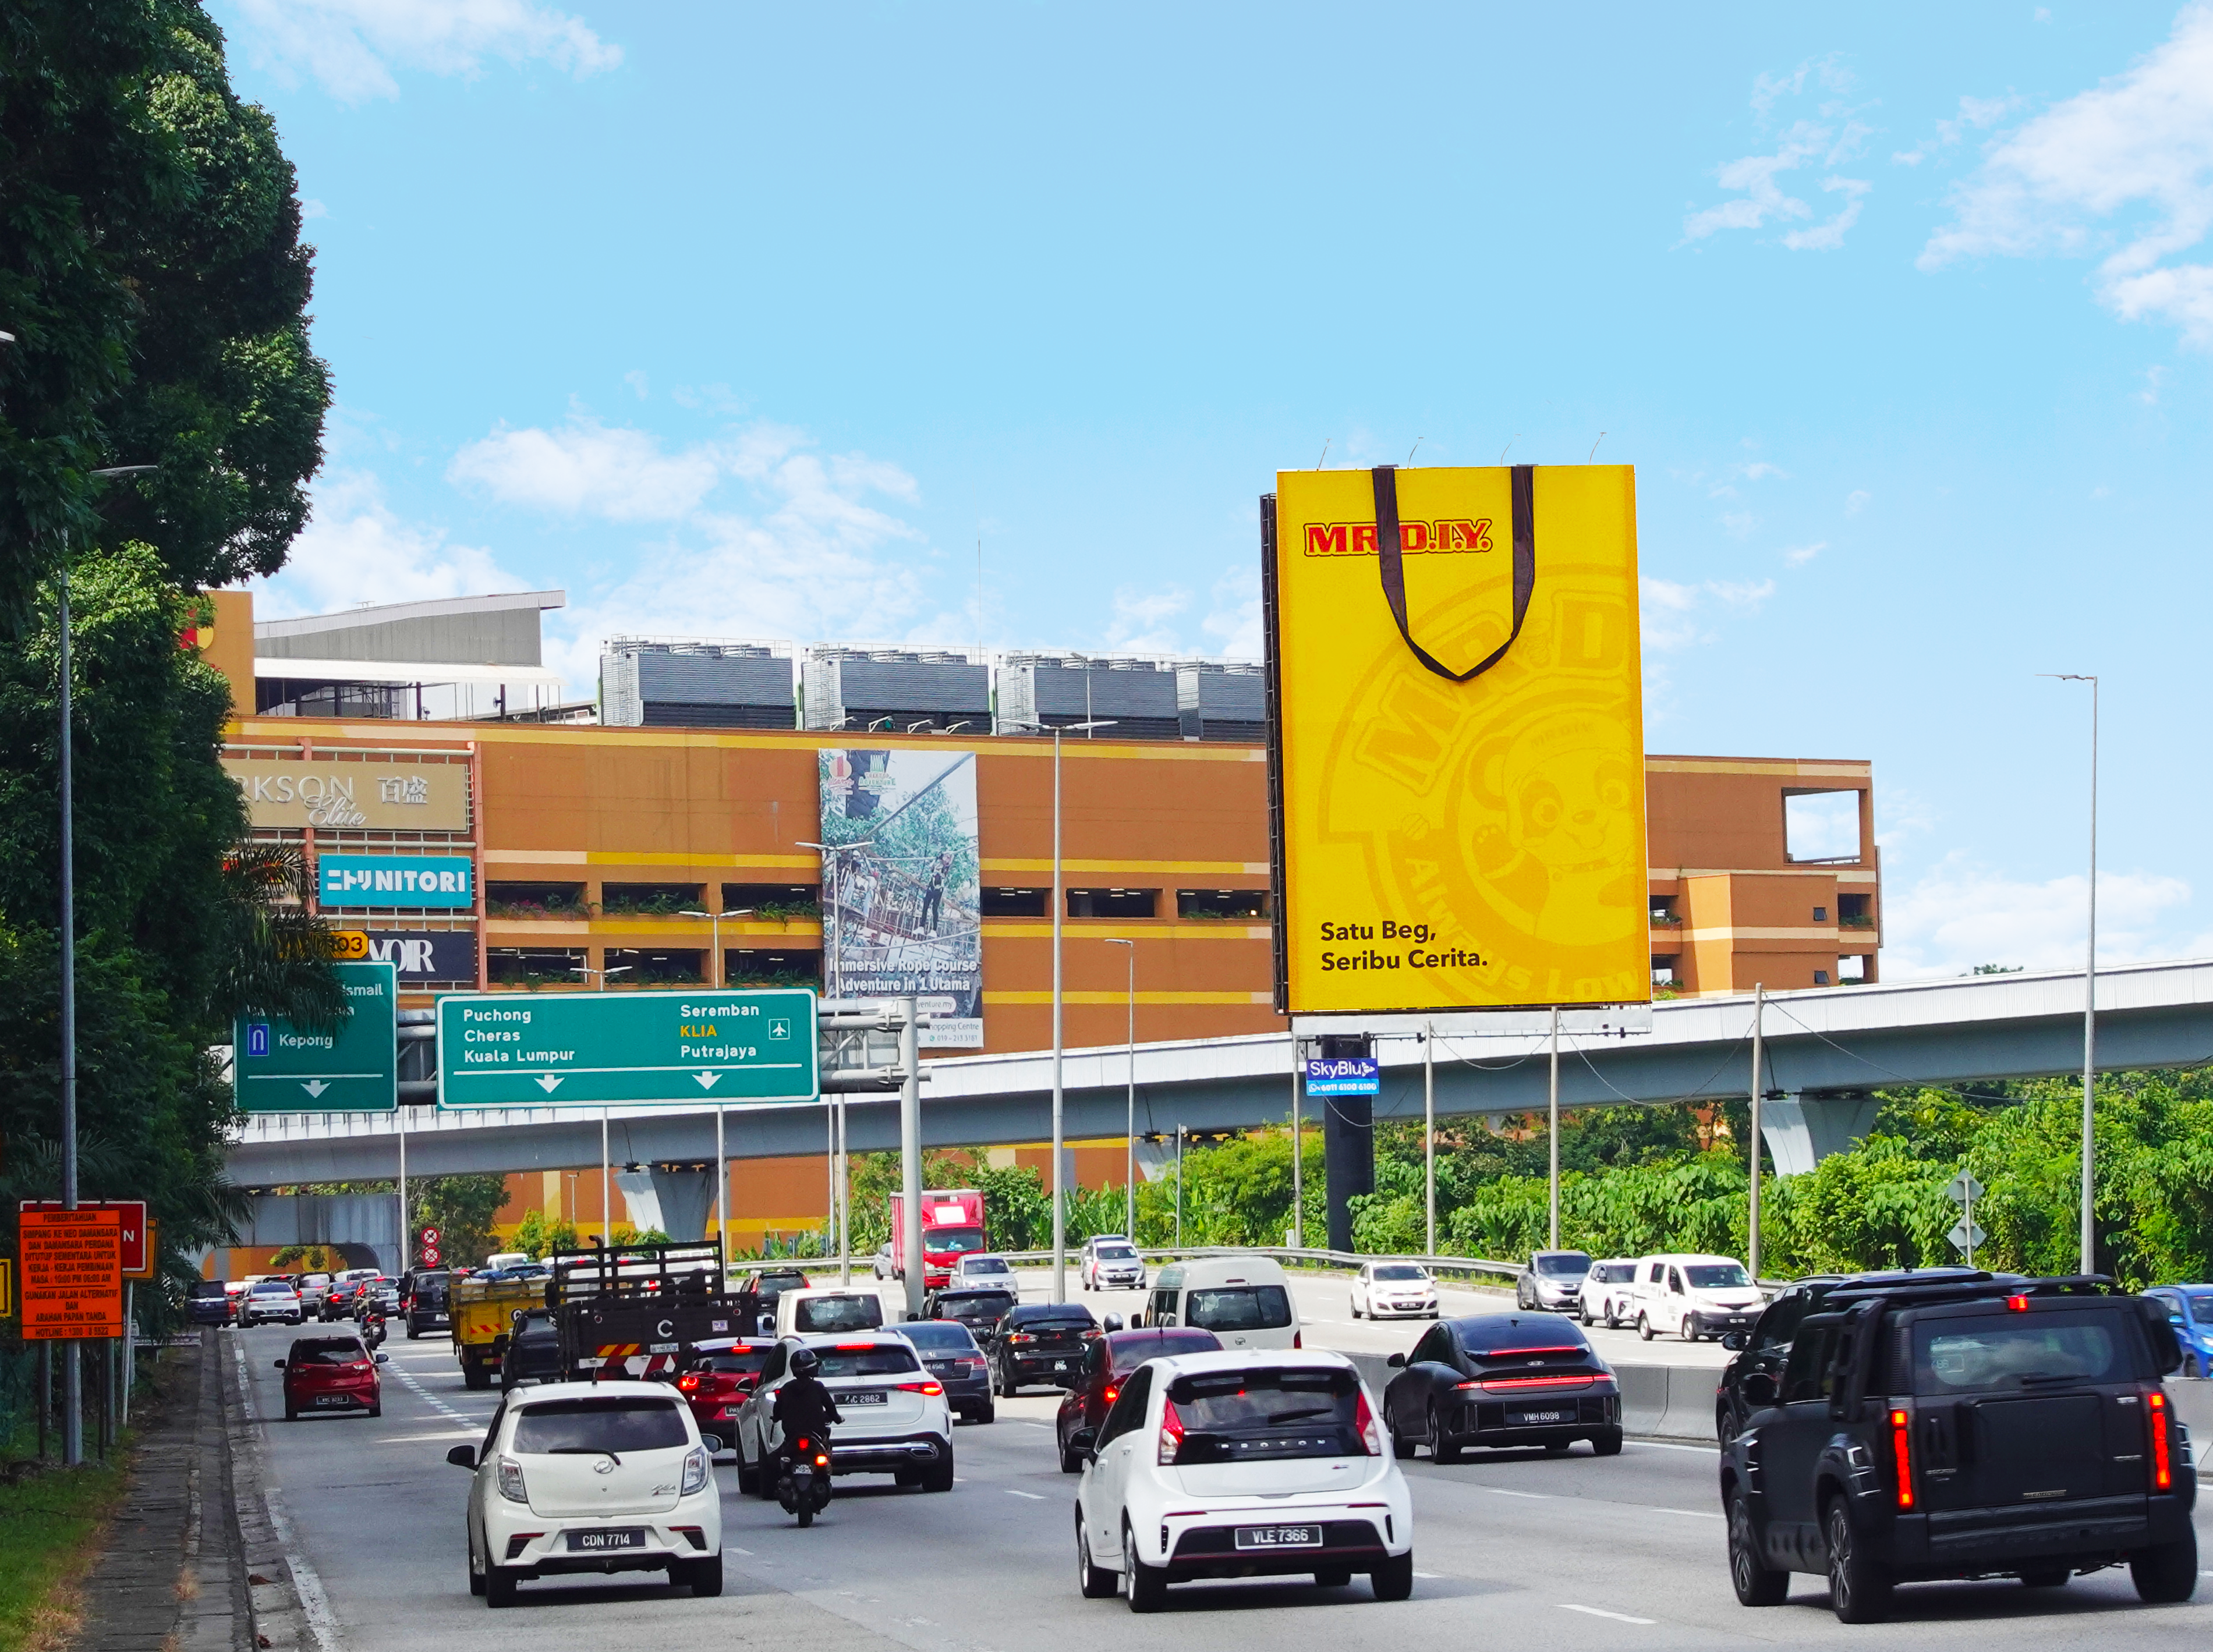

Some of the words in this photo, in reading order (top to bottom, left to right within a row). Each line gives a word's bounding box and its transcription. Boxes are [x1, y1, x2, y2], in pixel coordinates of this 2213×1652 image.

[232, 775, 353, 803] RKSON
[377, 775, 429, 804] 百盛
[304, 795, 367, 827] Elite
[327, 869, 373, 891] ニトリ
[375, 870, 466, 893] NITORI
[1320, 921, 1373, 941] Satu
[1382, 920, 1436, 944] Beg,
[829, 958, 894, 972] Immersive
[898, 959, 930, 973] Rope
[934, 959, 978, 972] Course
[1320, 949, 1400, 971] Seribu
[1408, 948, 1488, 969] Cerita.
[904, 977, 916, 991] in
[919, 978, 927, 990] 1
[931, 977, 971, 991] Utama
[463, 1008, 532, 1024] Puchong
[680, 1004, 759, 1018] Seremban
[680, 1024, 717, 1038] KLIA
[958, 1022, 980, 1030] Centre
[279, 1034, 333, 1049] Kepong
[464, 1029, 521, 1043] Cheras
[464, 1050, 509, 1063] Kuala
[516, 1048, 575, 1065] Lumpur
[681, 1044, 757, 1061] Putrajaya
[1358, 1083, 1377, 1091] 6100
[657, 1319, 673, 1338] C
[582, 1534, 605, 1547] CDN
[607, 1533, 630, 1545] 7714
[1252, 1529, 1277, 1544] VLE
[1277, 1529, 1309, 1542] 7366
